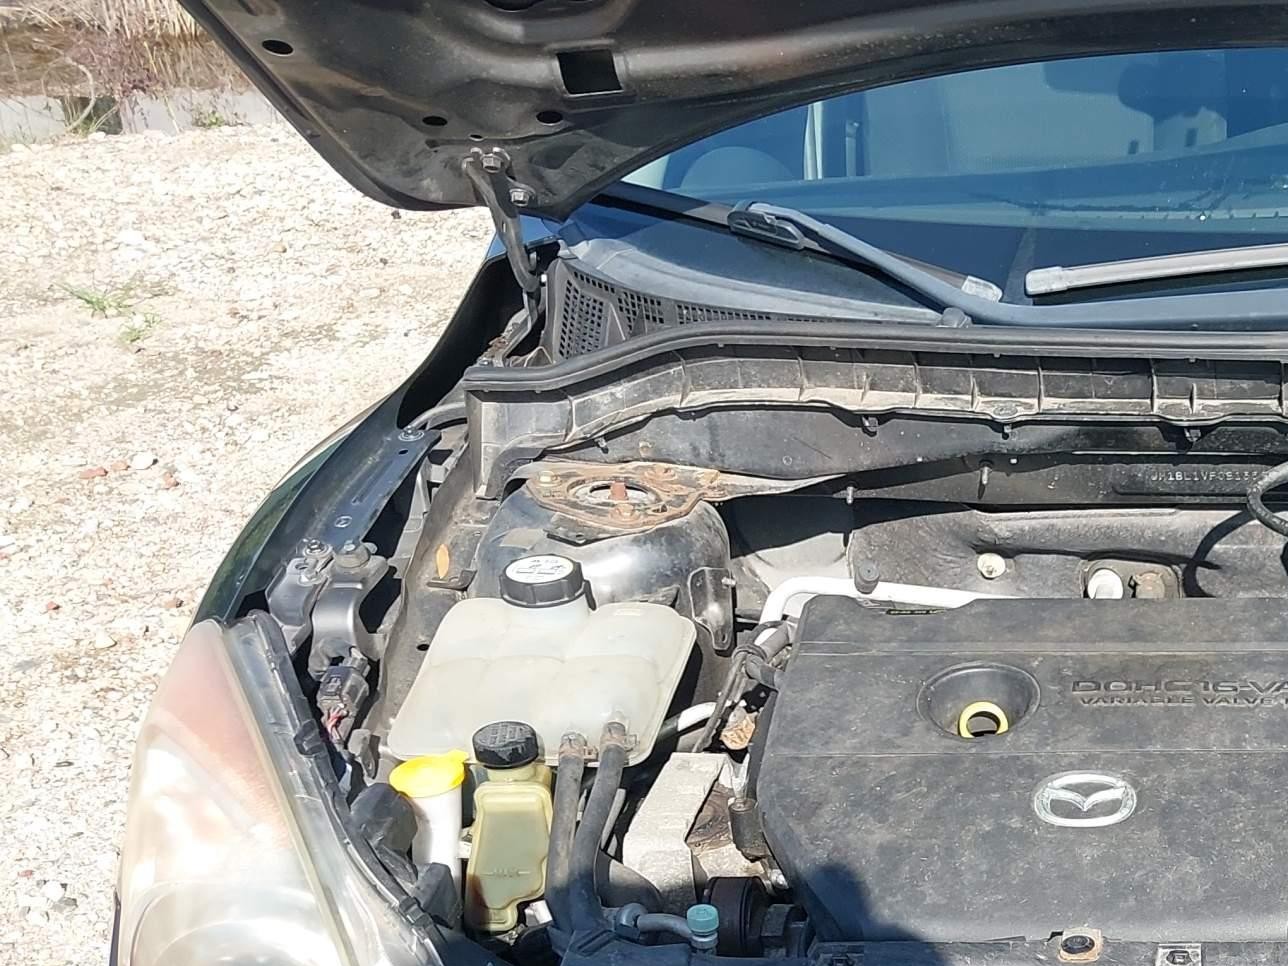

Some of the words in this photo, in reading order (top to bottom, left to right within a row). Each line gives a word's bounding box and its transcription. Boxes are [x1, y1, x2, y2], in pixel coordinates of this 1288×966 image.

[1071, 680, 1193, 694] DOHC
[1080, 696, 1194, 707] VARIABLE
[1201, 696, 1275, 708] VALVE
